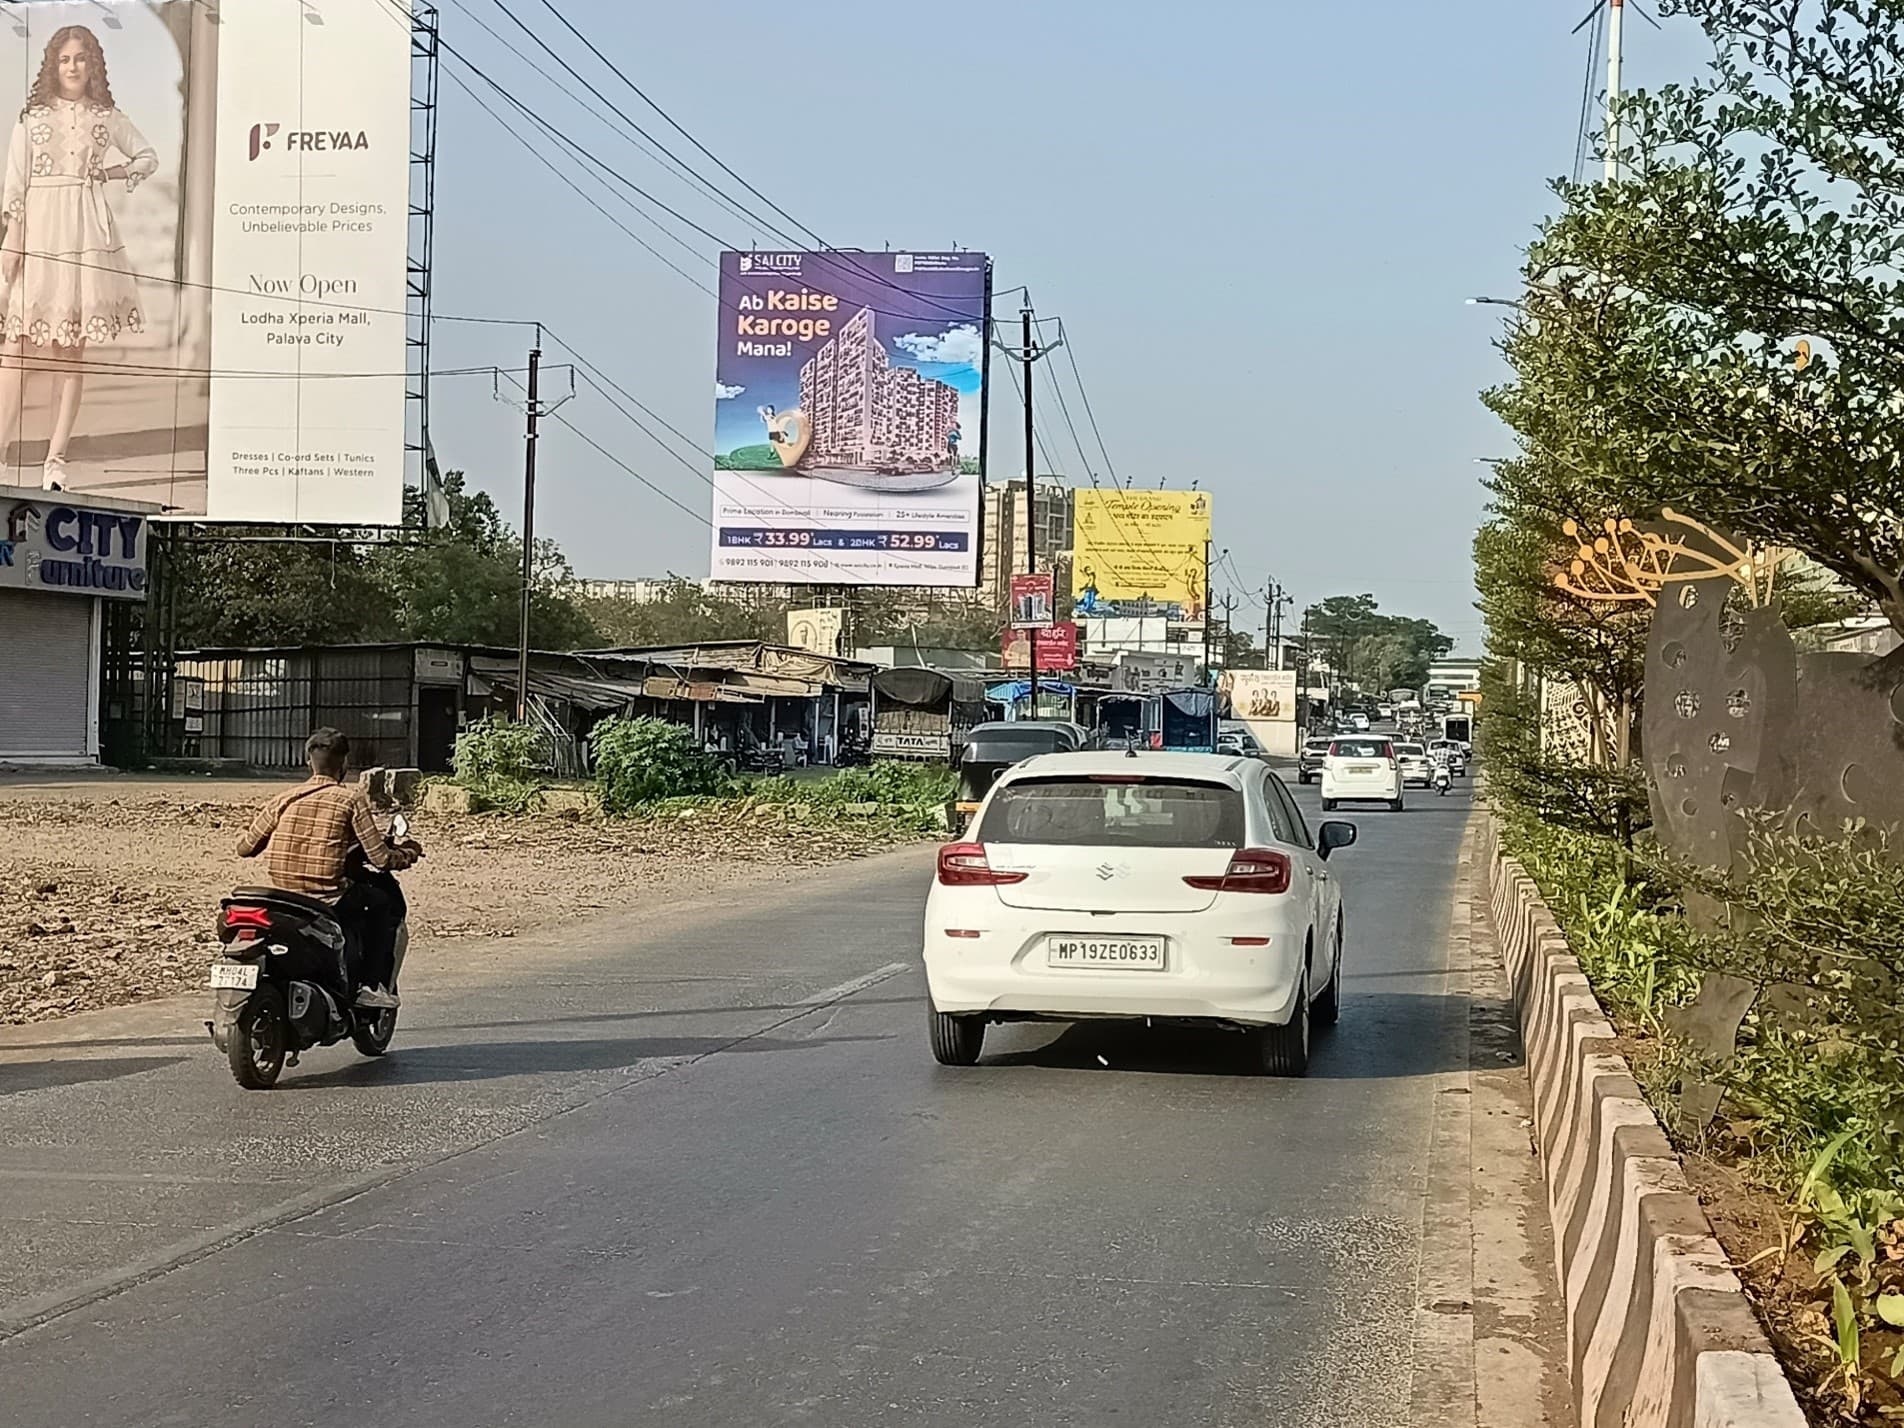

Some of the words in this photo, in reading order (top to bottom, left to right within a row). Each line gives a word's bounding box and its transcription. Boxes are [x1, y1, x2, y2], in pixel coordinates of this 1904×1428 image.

[287, 131, 369, 151] FREYAA
[229, 203, 326, 217] Contemporary
[330, 202, 387, 216] Designs,
[242, 220, 328, 232] Unbelievable
[332, 220, 373, 232] Prices
[754, 254, 774, 265] SAI
[776, 254, 802, 266] CITY
[250, 274, 293, 293] Now
[300, 274, 357, 299] Open
[739, 294, 764, 310] Ab
[767, 287, 839, 311] Kaise
[241, 312, 284, 324] Lodha
[289, 312, 334, 326] Xperia
[338, 312, 371, 326] Mall,
[738, 315, 831, 341] Karoge
[267, 332, 311, 345] Palava
[316, 332, 344, 347] City
[737, 341, 792, 356] Mana!
[232, 452, 269, 461] Dresses
[277, 453, 312, 462] Co-ord
[314, 453, 335, 462] Sets
[344, 453, 375, 463] Tunics
[233, 466, 259, 475] Three
[262, 466, 279, 476] Pcs
[288, 467, 324, 476] Kaftans
[334, 468, 374, 477] Western
[45, 507, 142, 559] CITY
[727, 536, 751, 544] 1BHK
[813, 538, 833, 546] Lacs
[838, 538, 845, 546] &
[939, 541, 959, 549] Lacs
[896, 737, 924, 746] TATA
[1059, 943, 1158, 960] MP19ZE0633
